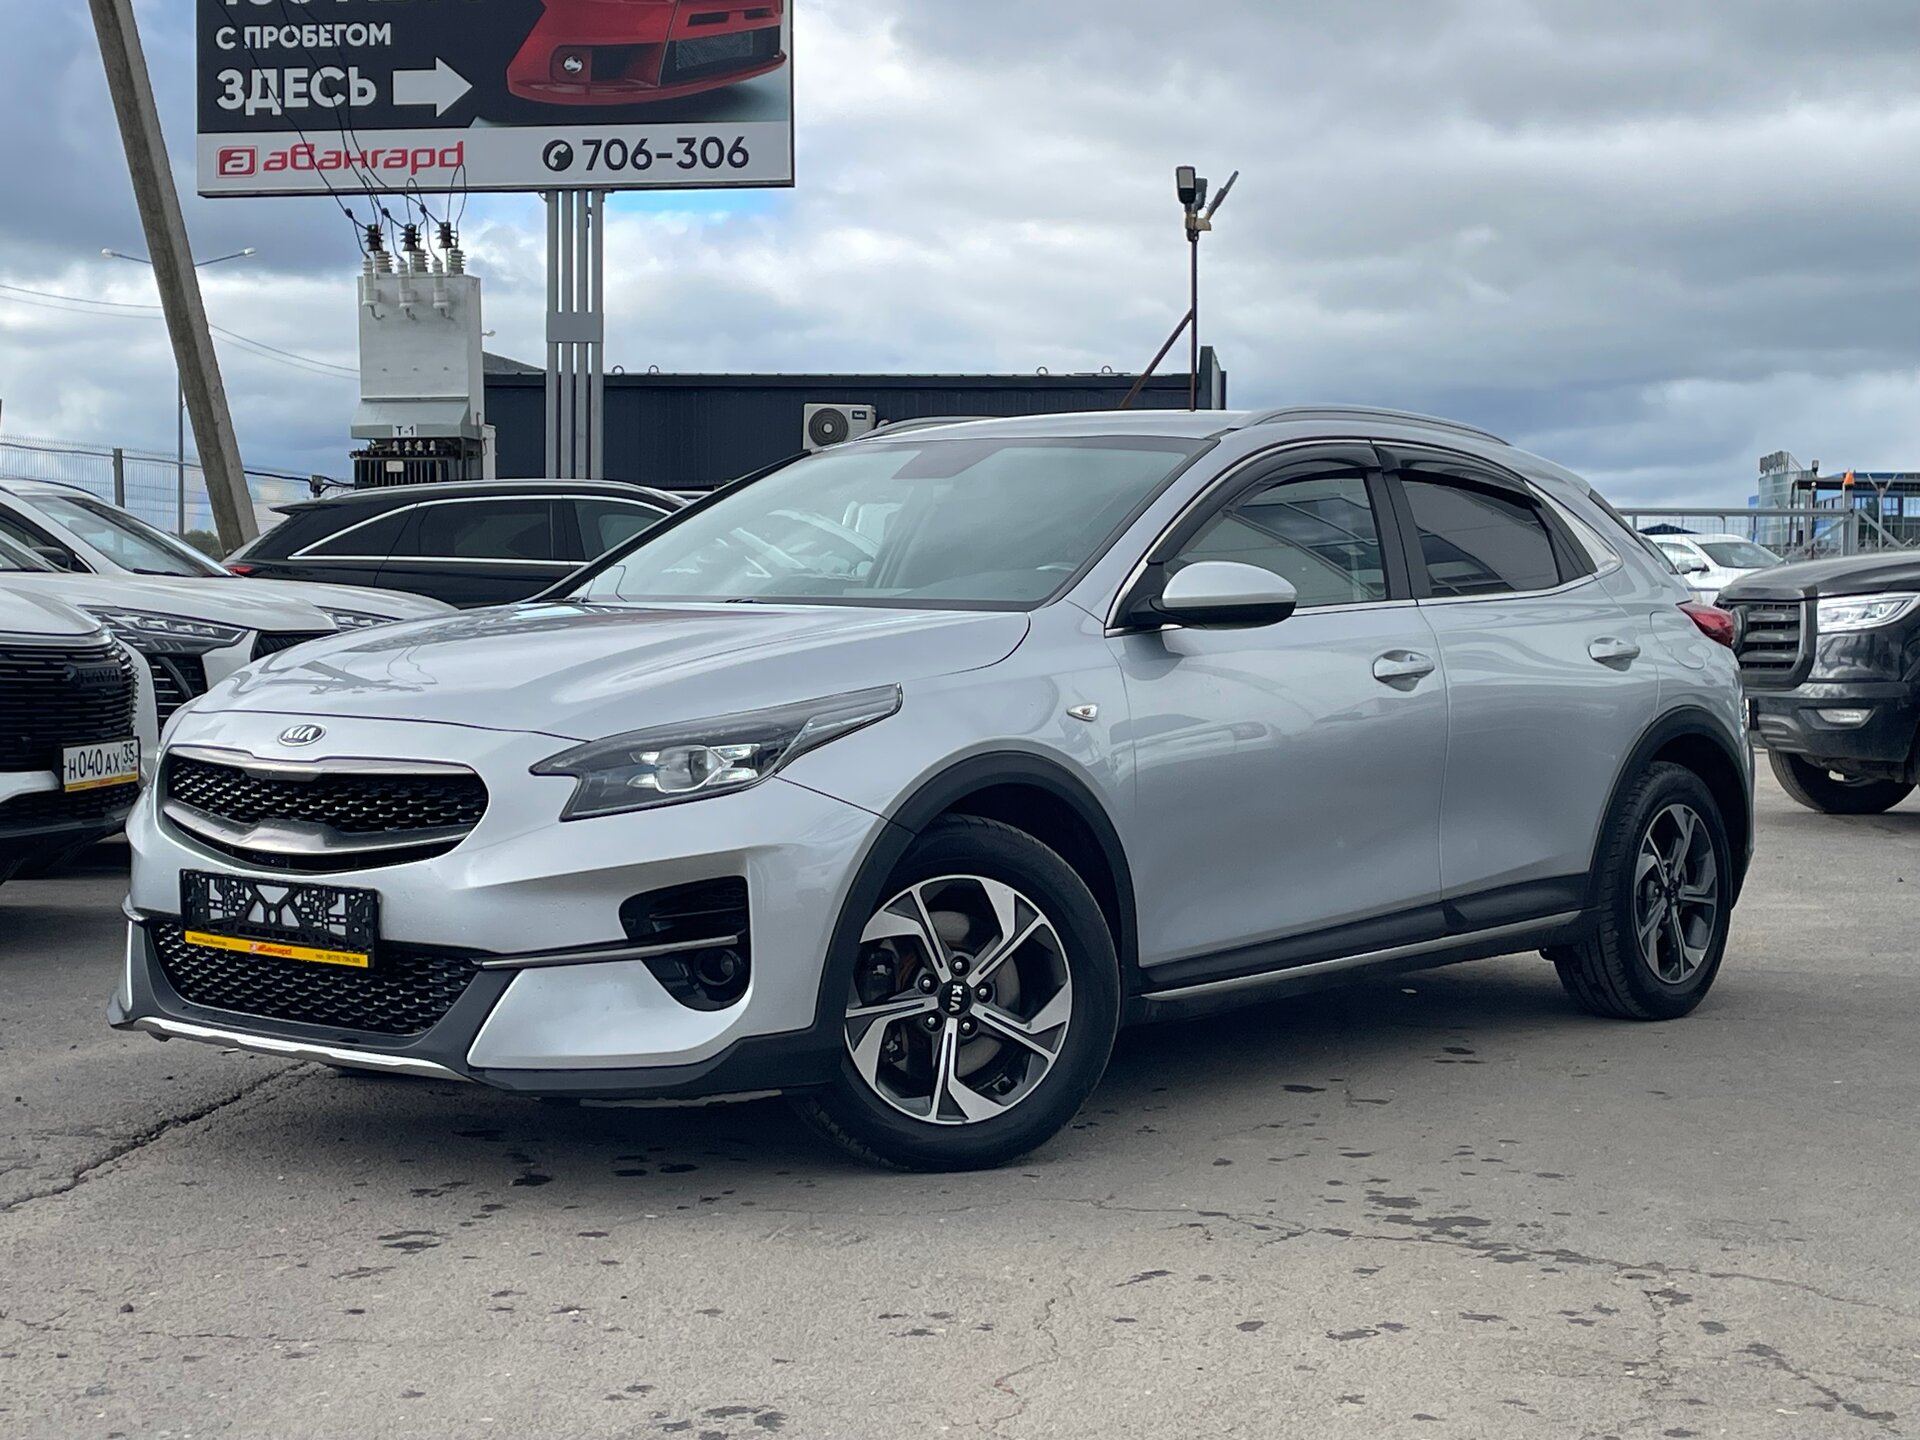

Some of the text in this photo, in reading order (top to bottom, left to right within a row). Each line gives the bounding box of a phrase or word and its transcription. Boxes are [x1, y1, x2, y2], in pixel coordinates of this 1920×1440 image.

[216, 22, 392, 50] С ПРОБЕГОМ
[216, 66, 377, 116] ЗДЕСЬ
[582, 136, 750, 171] 706-306
[282, 726, 317, 741] KIA
[949, 984, 963, 1012] KIA
